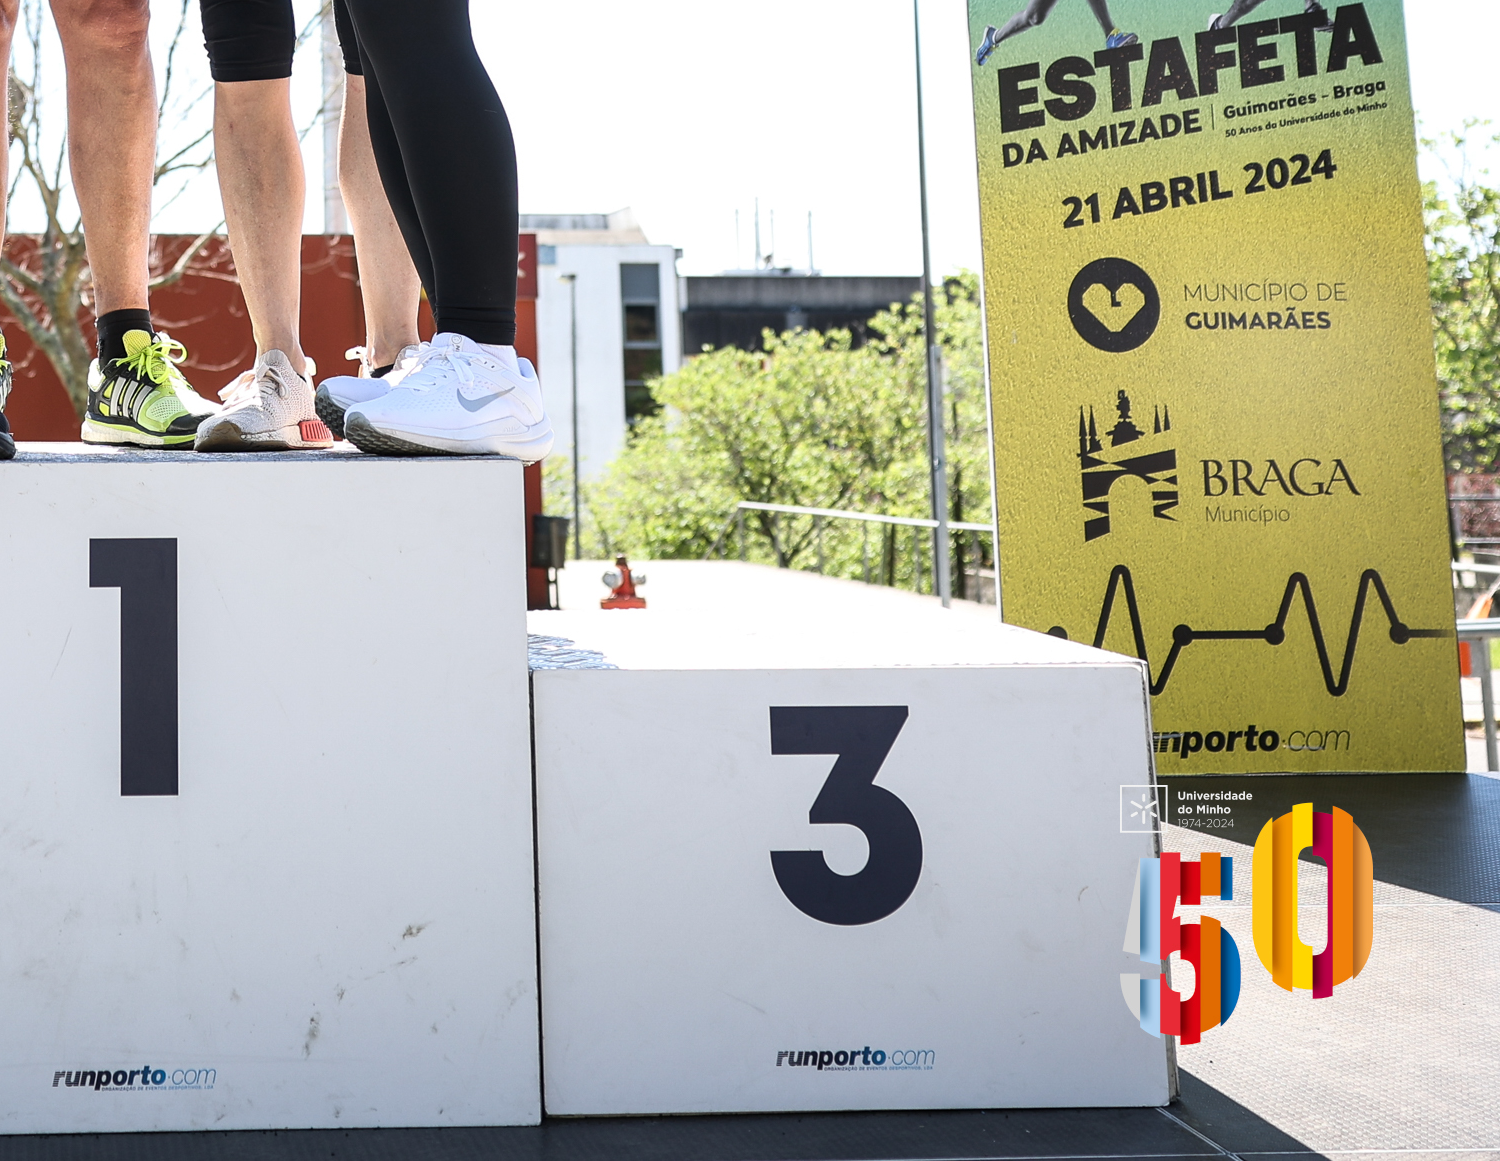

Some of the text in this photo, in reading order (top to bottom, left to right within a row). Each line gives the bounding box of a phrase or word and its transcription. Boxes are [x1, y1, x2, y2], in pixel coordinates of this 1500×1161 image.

[998, 3, 1384, 134] ESTAFETA
[1224, 81, 1386, 119] Guimarães Braga
[1226, 101, 1388, 137] 50 Anos da Universidade do Minho
[1002, 108, 1202, 168] DA AMIZADE
[1062, 149, 1337, 229] 21 ABRIL 2024
[1184, 278, 1348, 303] MUNICÍPIO DE
[1186, 307, 1332, 331] GUIMARÃES
[1200, 458, 1362, 497] BRAGA
[1205, 505, 1290, 525] Município
[89, 537, 178, 796] 1
[770, 705, 923, 926] 3
